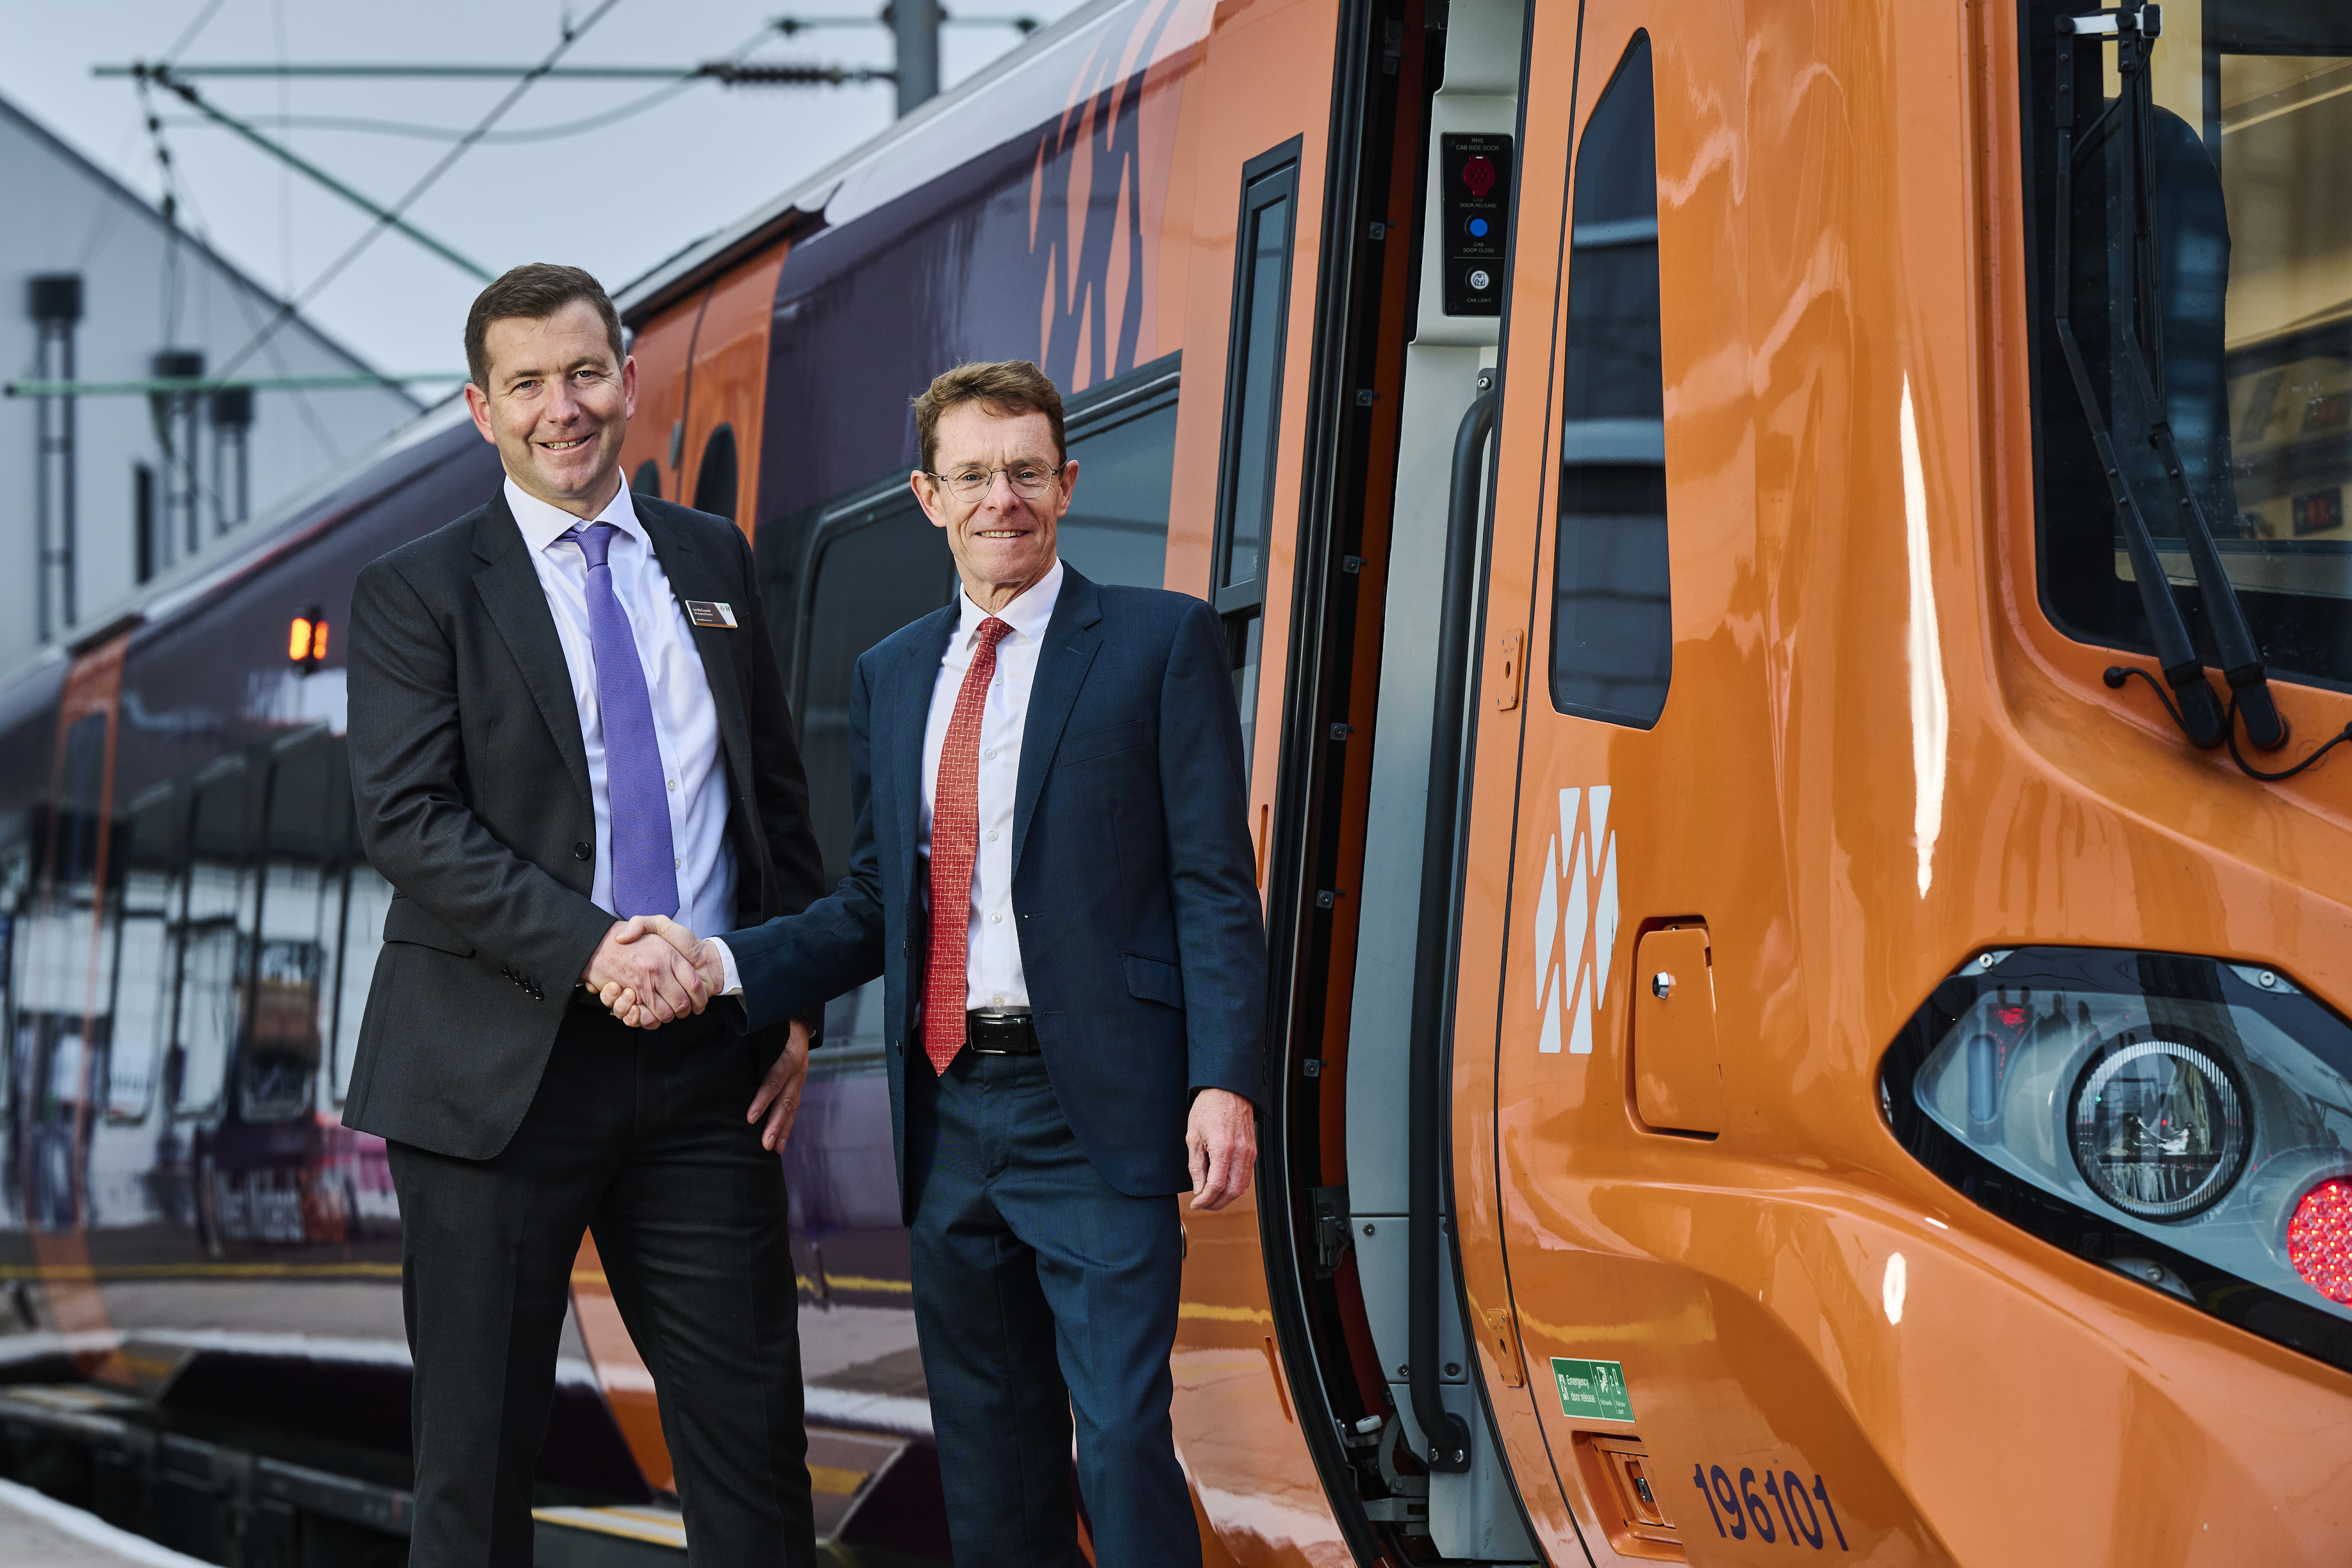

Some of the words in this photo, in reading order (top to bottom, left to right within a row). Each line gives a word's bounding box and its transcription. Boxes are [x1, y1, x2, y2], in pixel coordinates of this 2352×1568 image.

[1566, 1374, 1589, 1389] Emergency
[1609, 1375, 1614, 1387] 2
[1571, 1391, 1580, 1401] door
[1580, 1392, 1595, 1403] release
[1693, 1464, 1849, 1551] 196101
